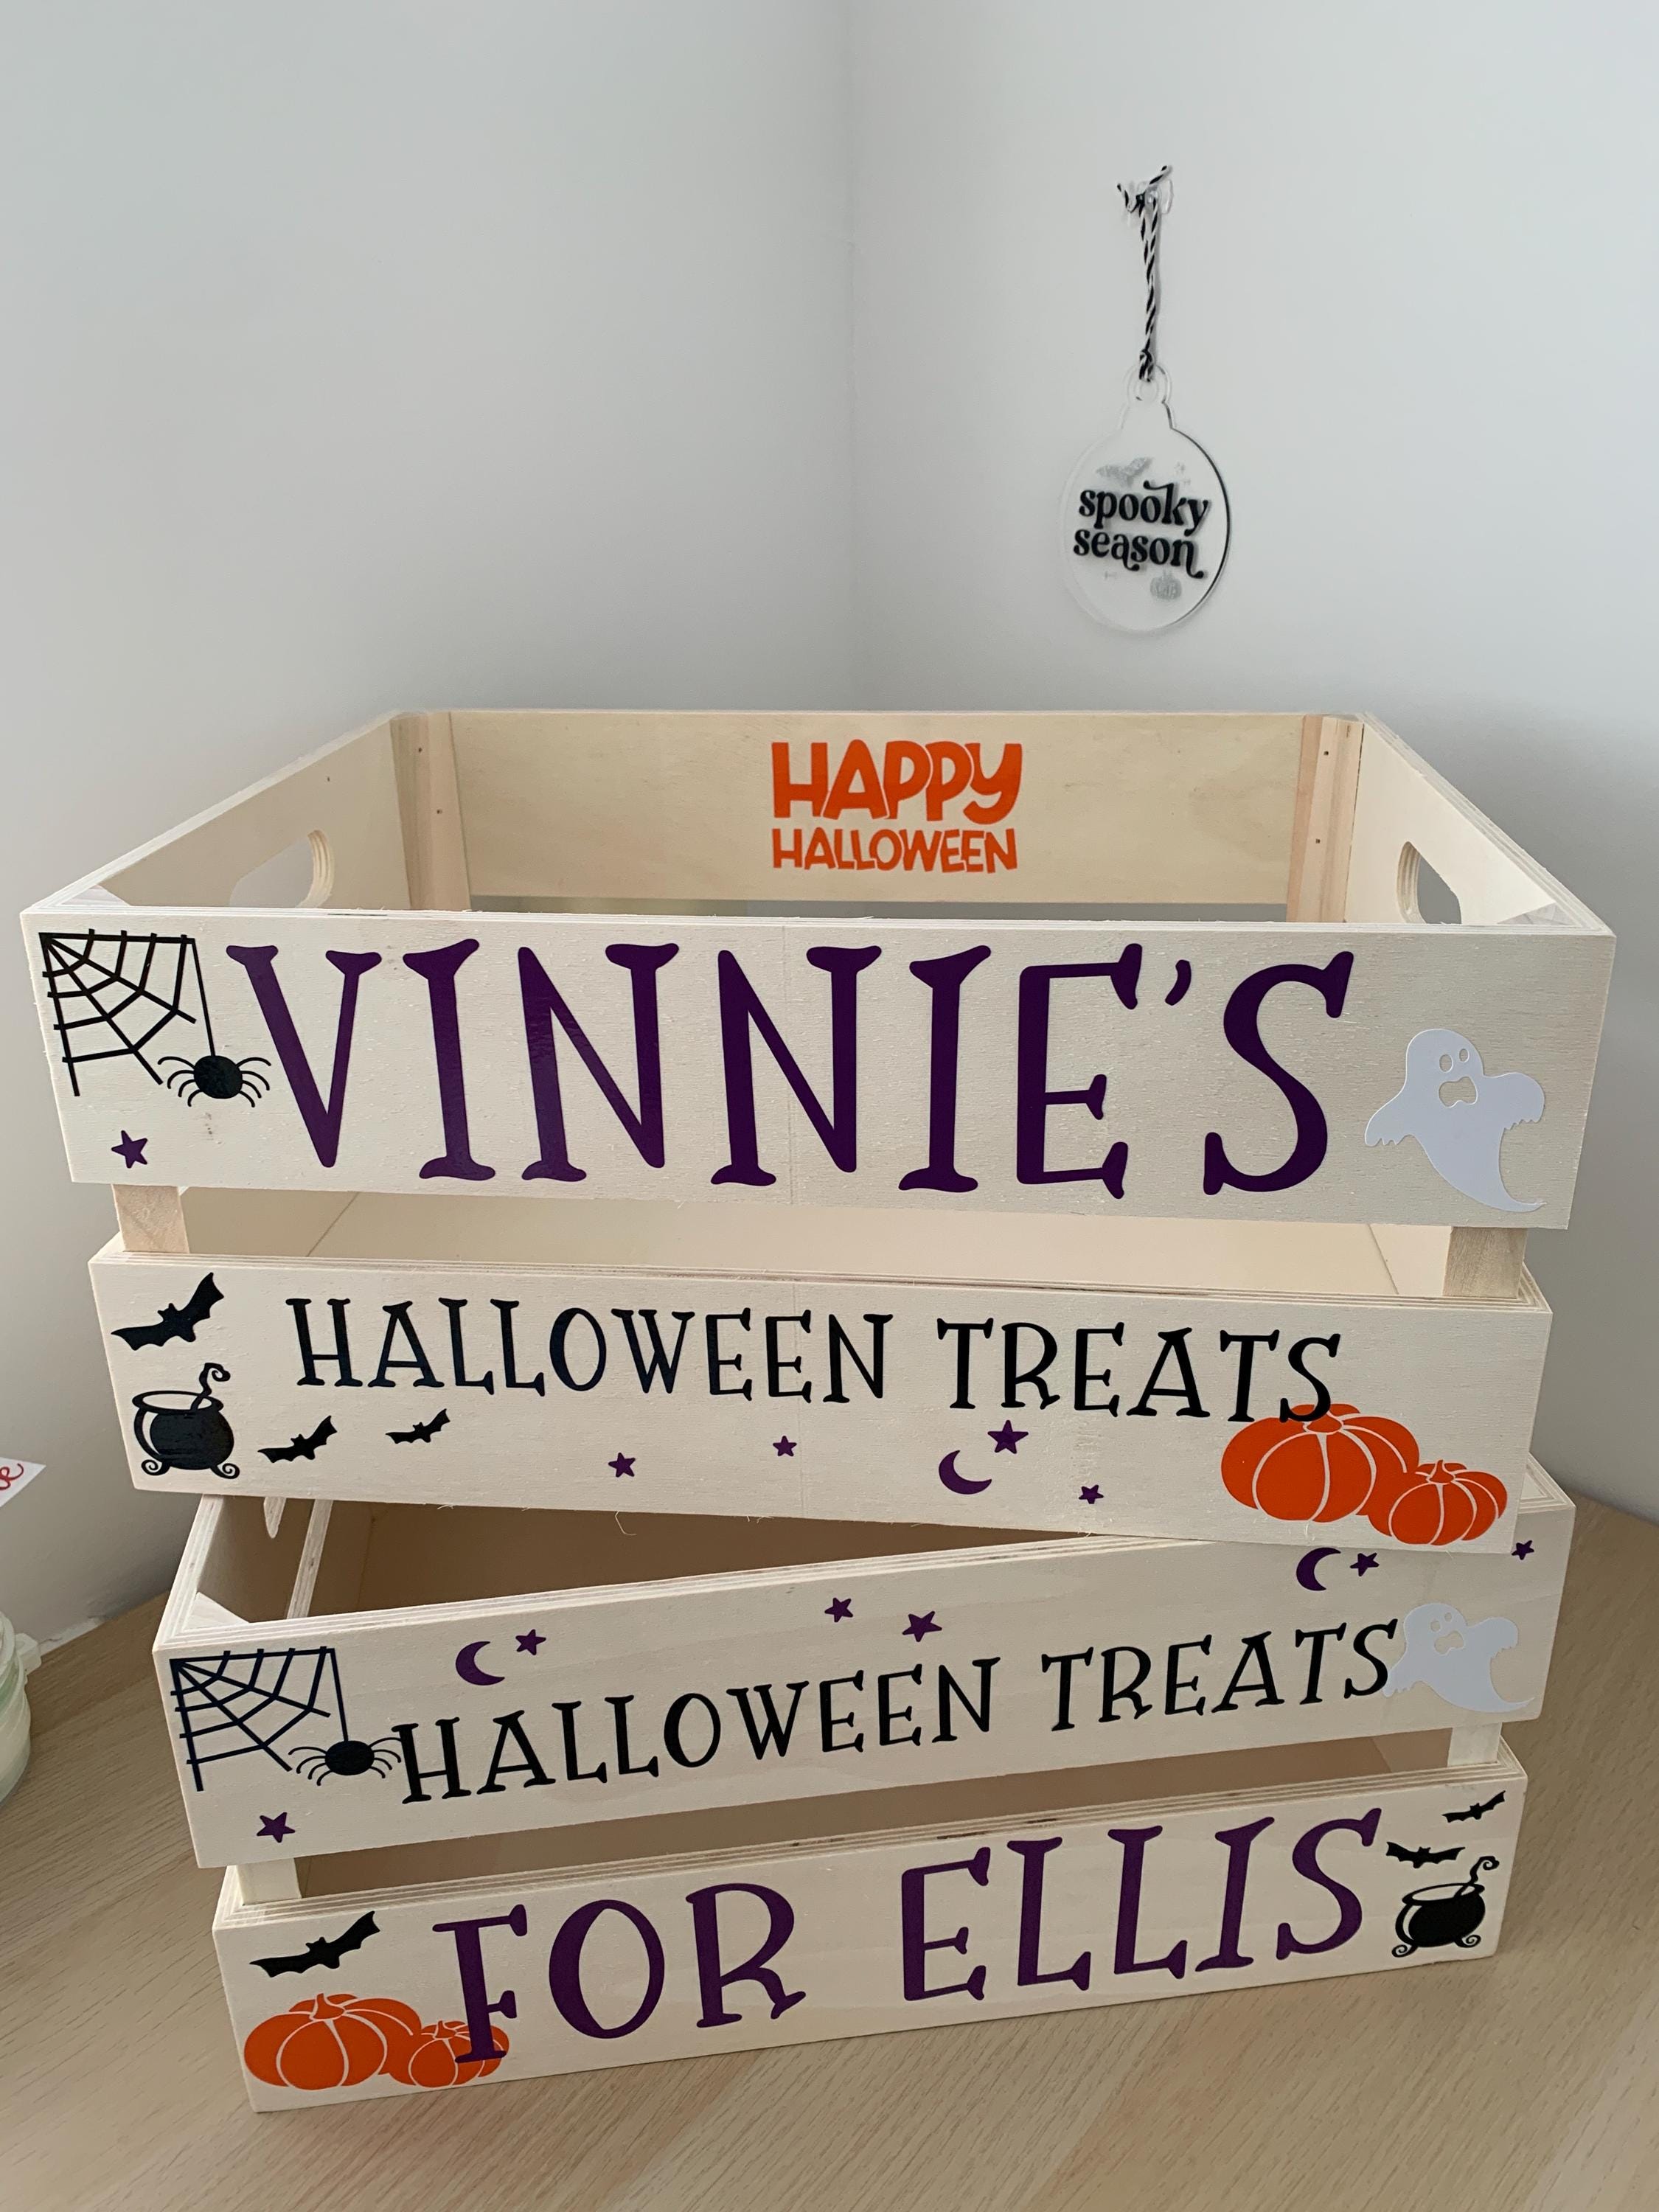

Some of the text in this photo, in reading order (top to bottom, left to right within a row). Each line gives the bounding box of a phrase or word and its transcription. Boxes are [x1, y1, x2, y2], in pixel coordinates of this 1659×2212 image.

[1074, 529, 1204, 579] season
[1079, 480, 1208, 536] spooky
[772, 739, 1023, 824] HAPPY
[772, 827, 1018, 873] HALLOWEEN
[226, 939, 1354, 1199] VINNIE'S
[285, 1297, 1340, 1423] HALLOWEEN TREATS
[392, 1618, 1398, 1804] HALLOWEEN TREATS
[432, 1808, 1382, 2063] FOR ELLIS
